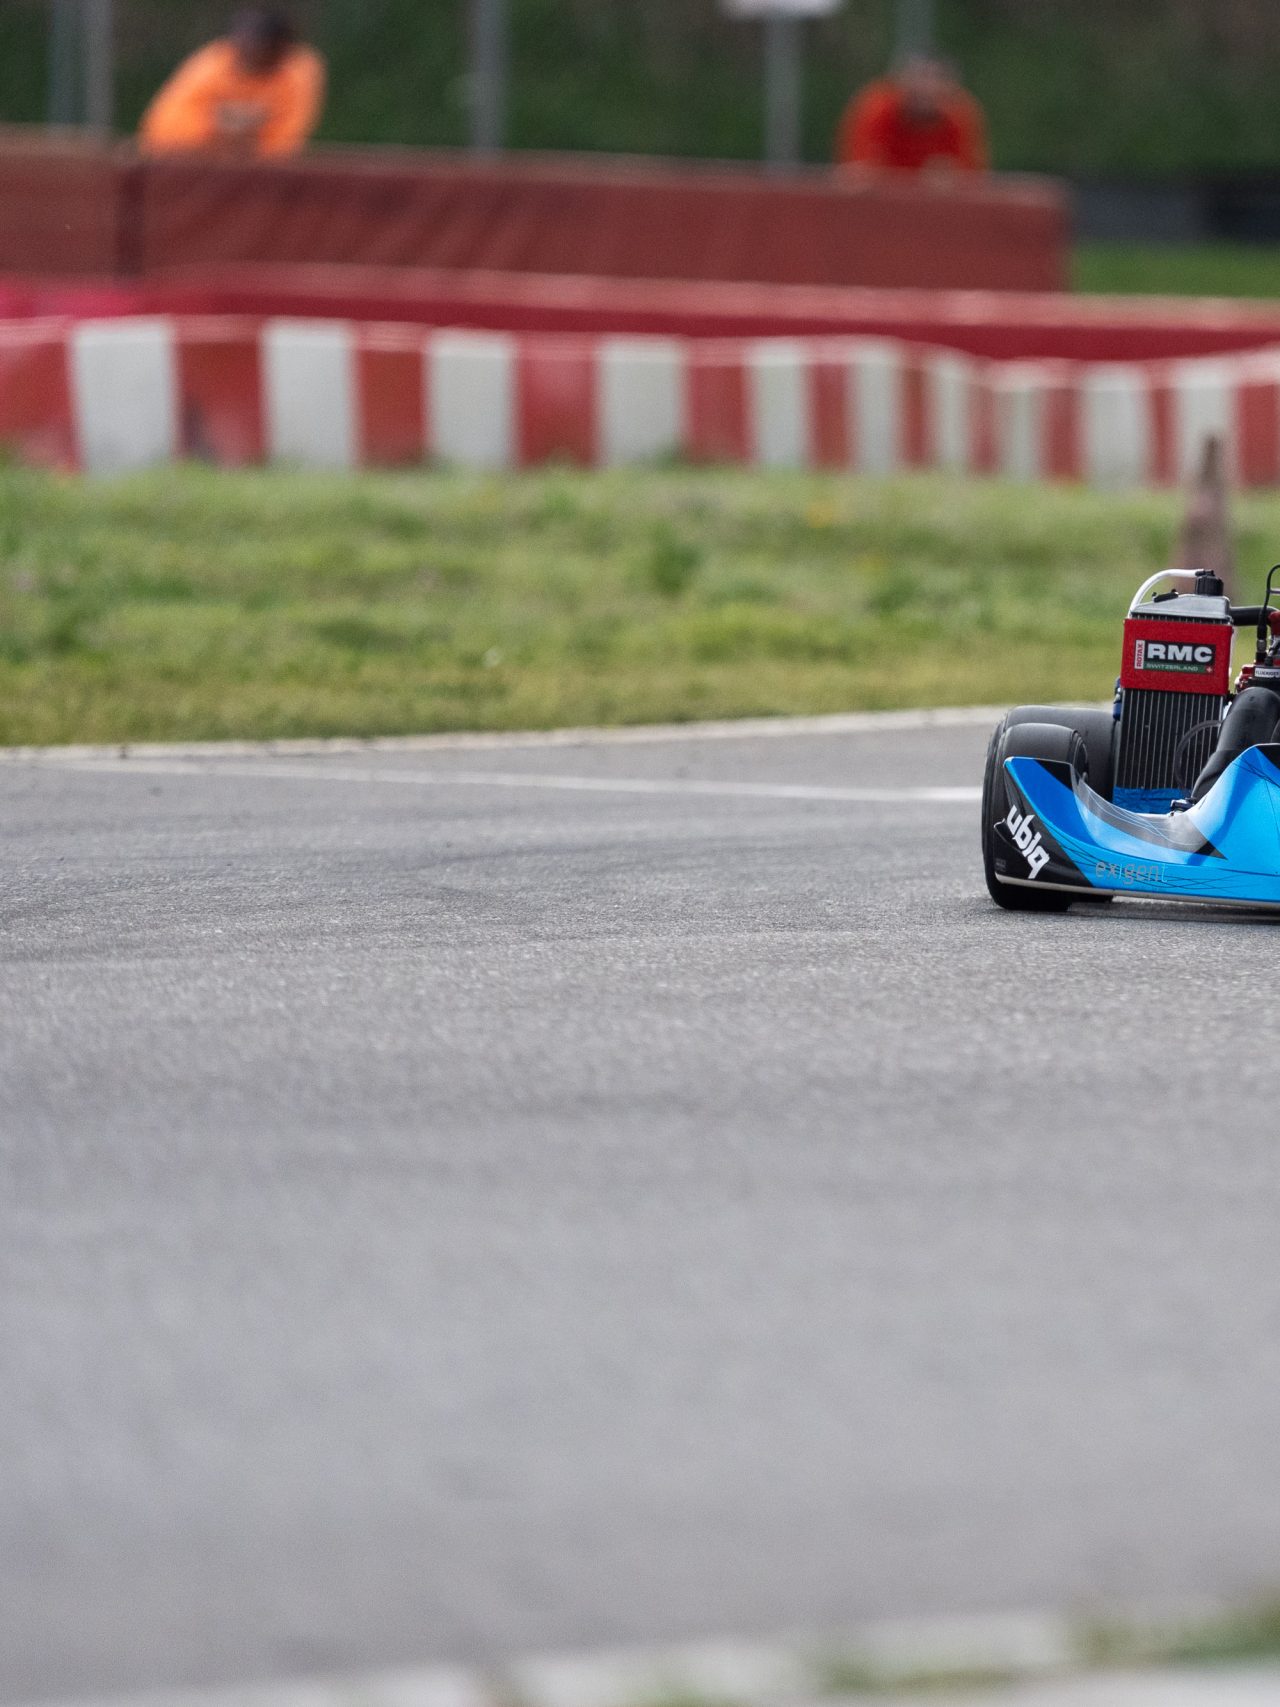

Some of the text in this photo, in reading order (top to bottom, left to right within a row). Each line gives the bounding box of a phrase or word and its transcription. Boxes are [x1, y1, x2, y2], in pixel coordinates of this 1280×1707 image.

[1135, 643, 1144, 668] ROTAX
[1147, 643, 1213, 662] RMC
[1146, 662, 1200, 673] SWITZERLAND
